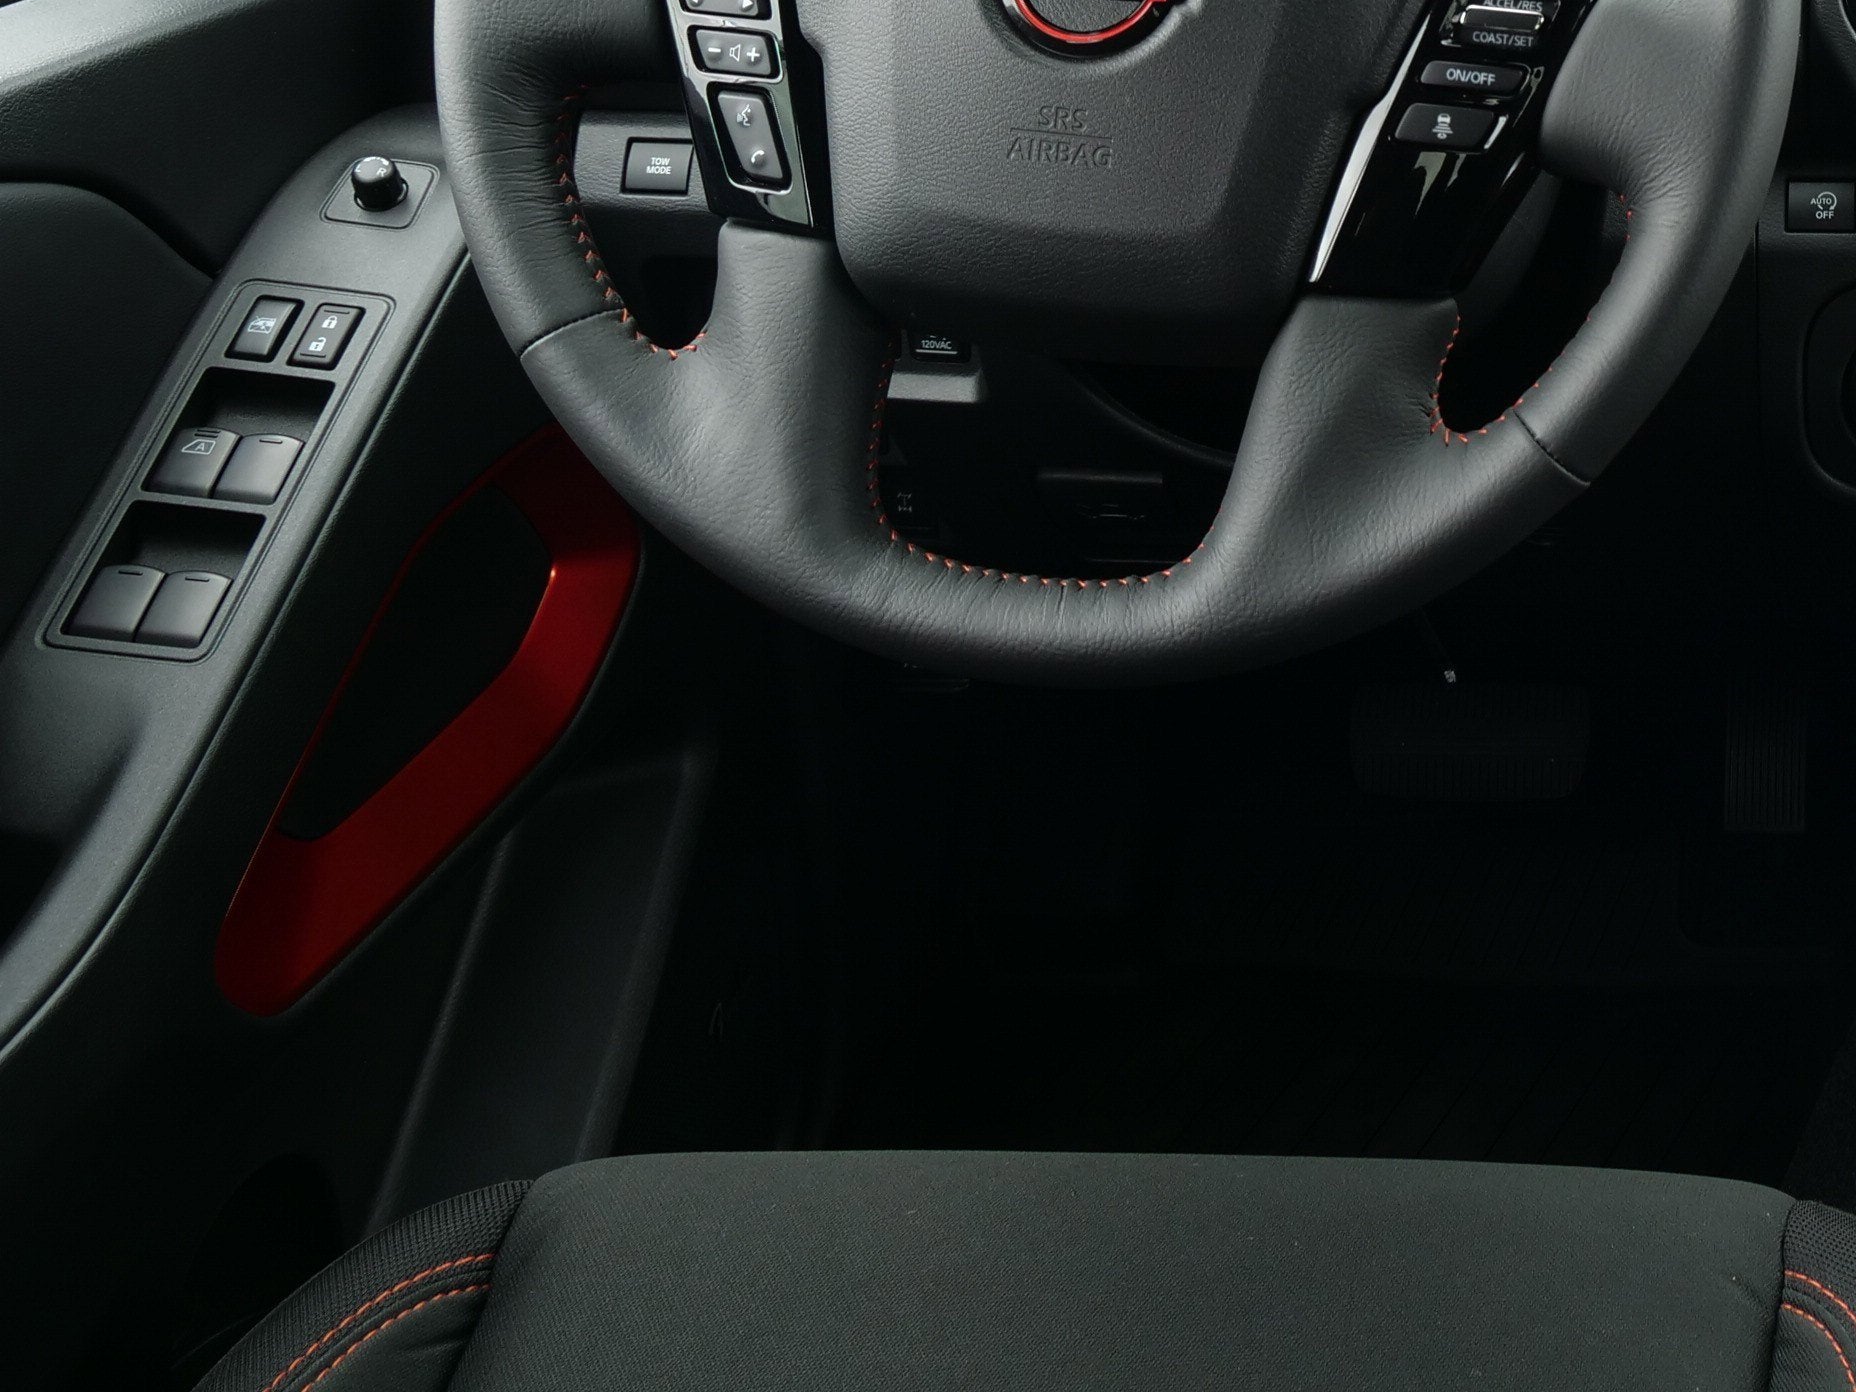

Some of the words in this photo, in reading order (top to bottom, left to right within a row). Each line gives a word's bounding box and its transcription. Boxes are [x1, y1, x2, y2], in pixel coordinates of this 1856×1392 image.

[1472, 31, 1534, 47] COAST/SET
[1446, 68, 1496, 86] ON/OFF
[1038, 106, 1087, 130] SRS
[1006, 136, 1114, 168] AIRBAG
[650, 156, 671, 166] TOW
[376, 167, 387, 177] R
[646, 165, 672, 175] MODE
[1810, 197, 1832, 206] AUTO
[1816, 210, 1834, 219] OFF
[921, 340, 952, 350] 120VAC
